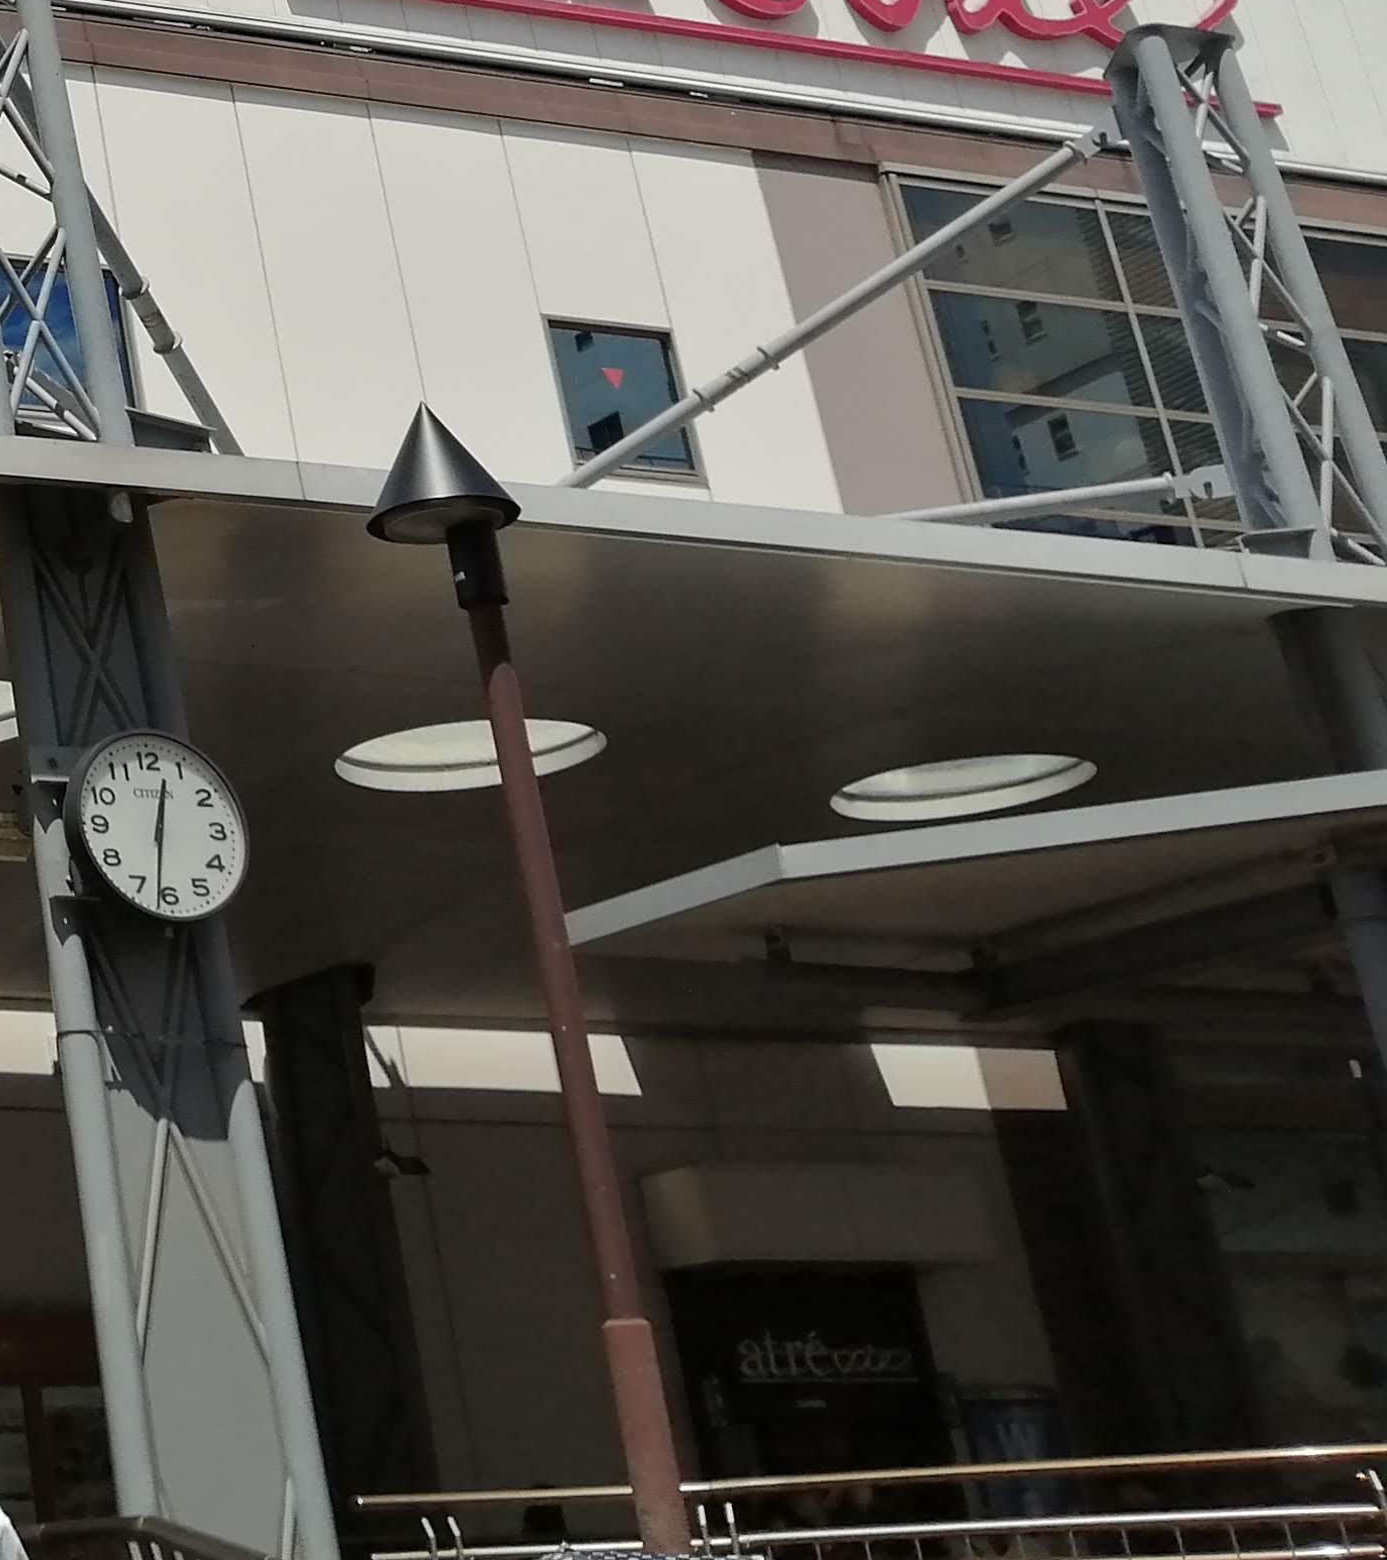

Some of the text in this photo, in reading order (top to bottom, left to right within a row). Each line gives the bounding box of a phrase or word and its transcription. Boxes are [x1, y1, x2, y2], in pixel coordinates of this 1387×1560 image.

[136, 751, 160, 771] 12
[175, 761, 183, 780] 1
[108, 762, 130, 781] 11
[91, 786, 116, 805] 10
[133, 788, 173, 800] CITIZN
[195, 789, 214, 807] 2
[91, 814, 109, 834] 9
[209, 822, 227, 841] 3
[103, 848, 121, 866] 8
[205, 854, 225, 872] 4
[128, 874, 146, 893] 7
[191, 878, 210, 897] 5
[160, 886, 179, 905] 6
